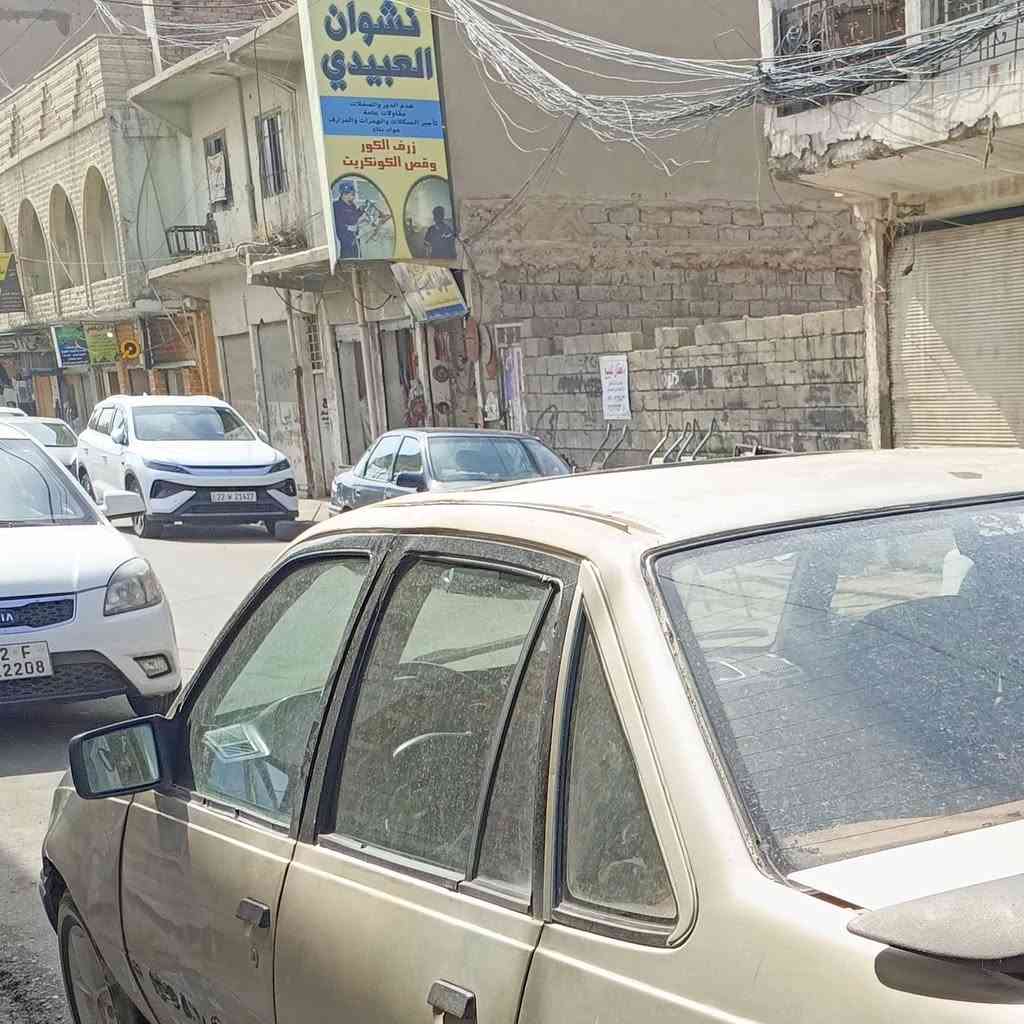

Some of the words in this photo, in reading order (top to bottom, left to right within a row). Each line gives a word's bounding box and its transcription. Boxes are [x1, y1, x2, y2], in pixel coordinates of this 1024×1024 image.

[325, 1, 421, 47] نشوان
[322, 47, 435, 92] العبيدي
[361, 139, 390, 153] الكور
[343, 156, 401, 170] الكونكريت
[405, 158, 437, 171] وقص
[0, 660, 46, 678] 2208
